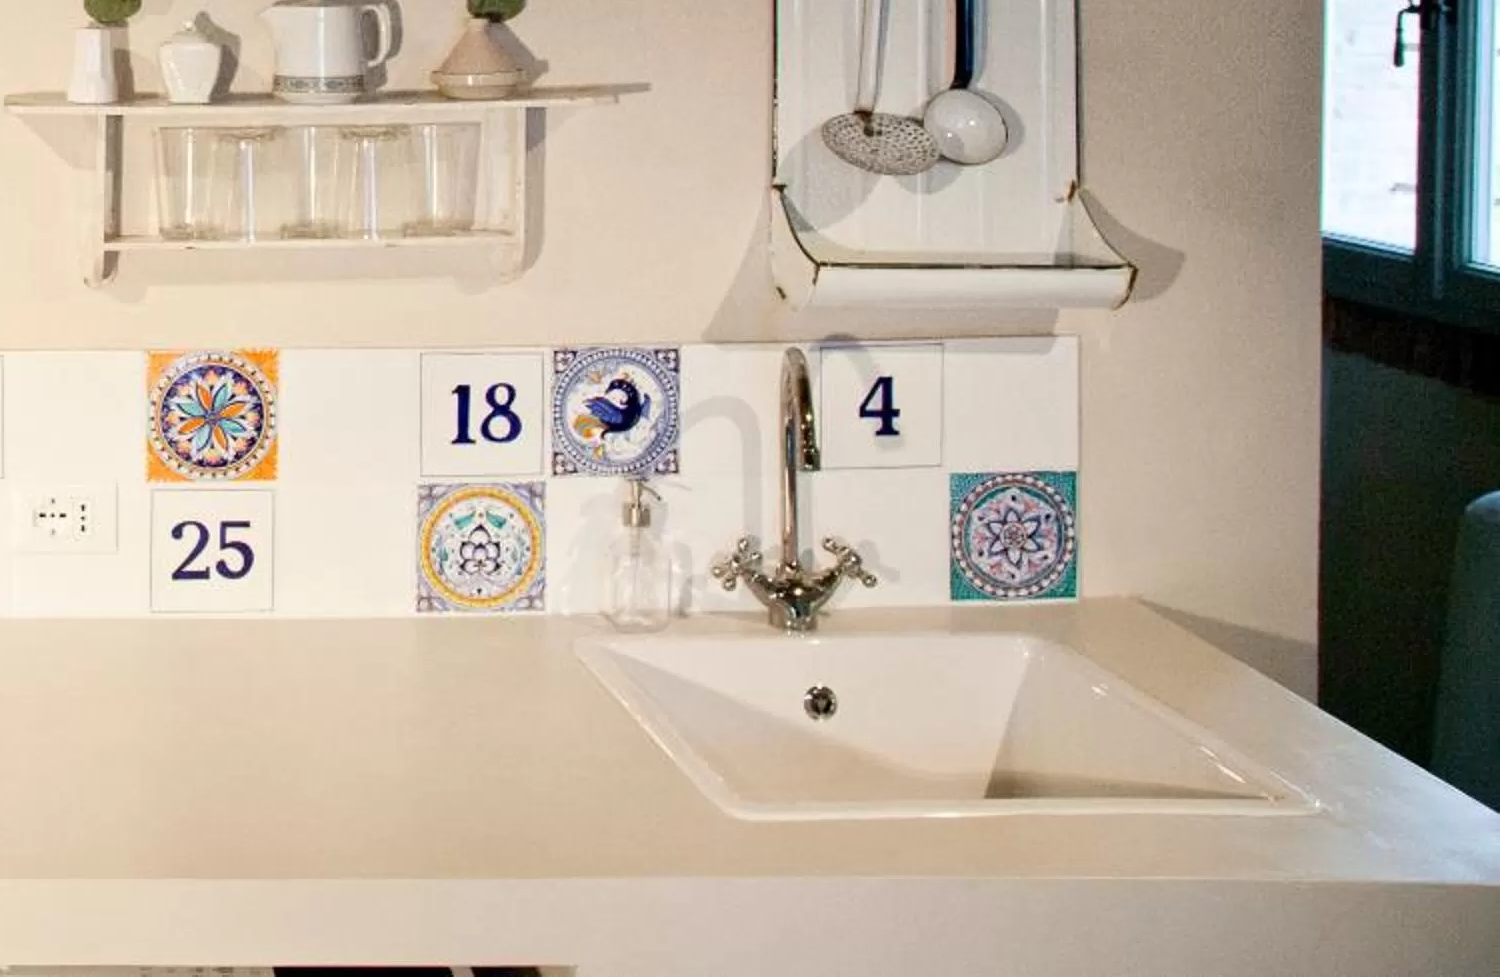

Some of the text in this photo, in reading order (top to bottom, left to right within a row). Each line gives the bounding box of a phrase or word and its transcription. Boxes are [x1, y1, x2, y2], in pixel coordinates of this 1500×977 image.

[451, 382, 523, 445] 18
[858, 375, 901, 437] 4
[171, 520, 255, 581] 25
